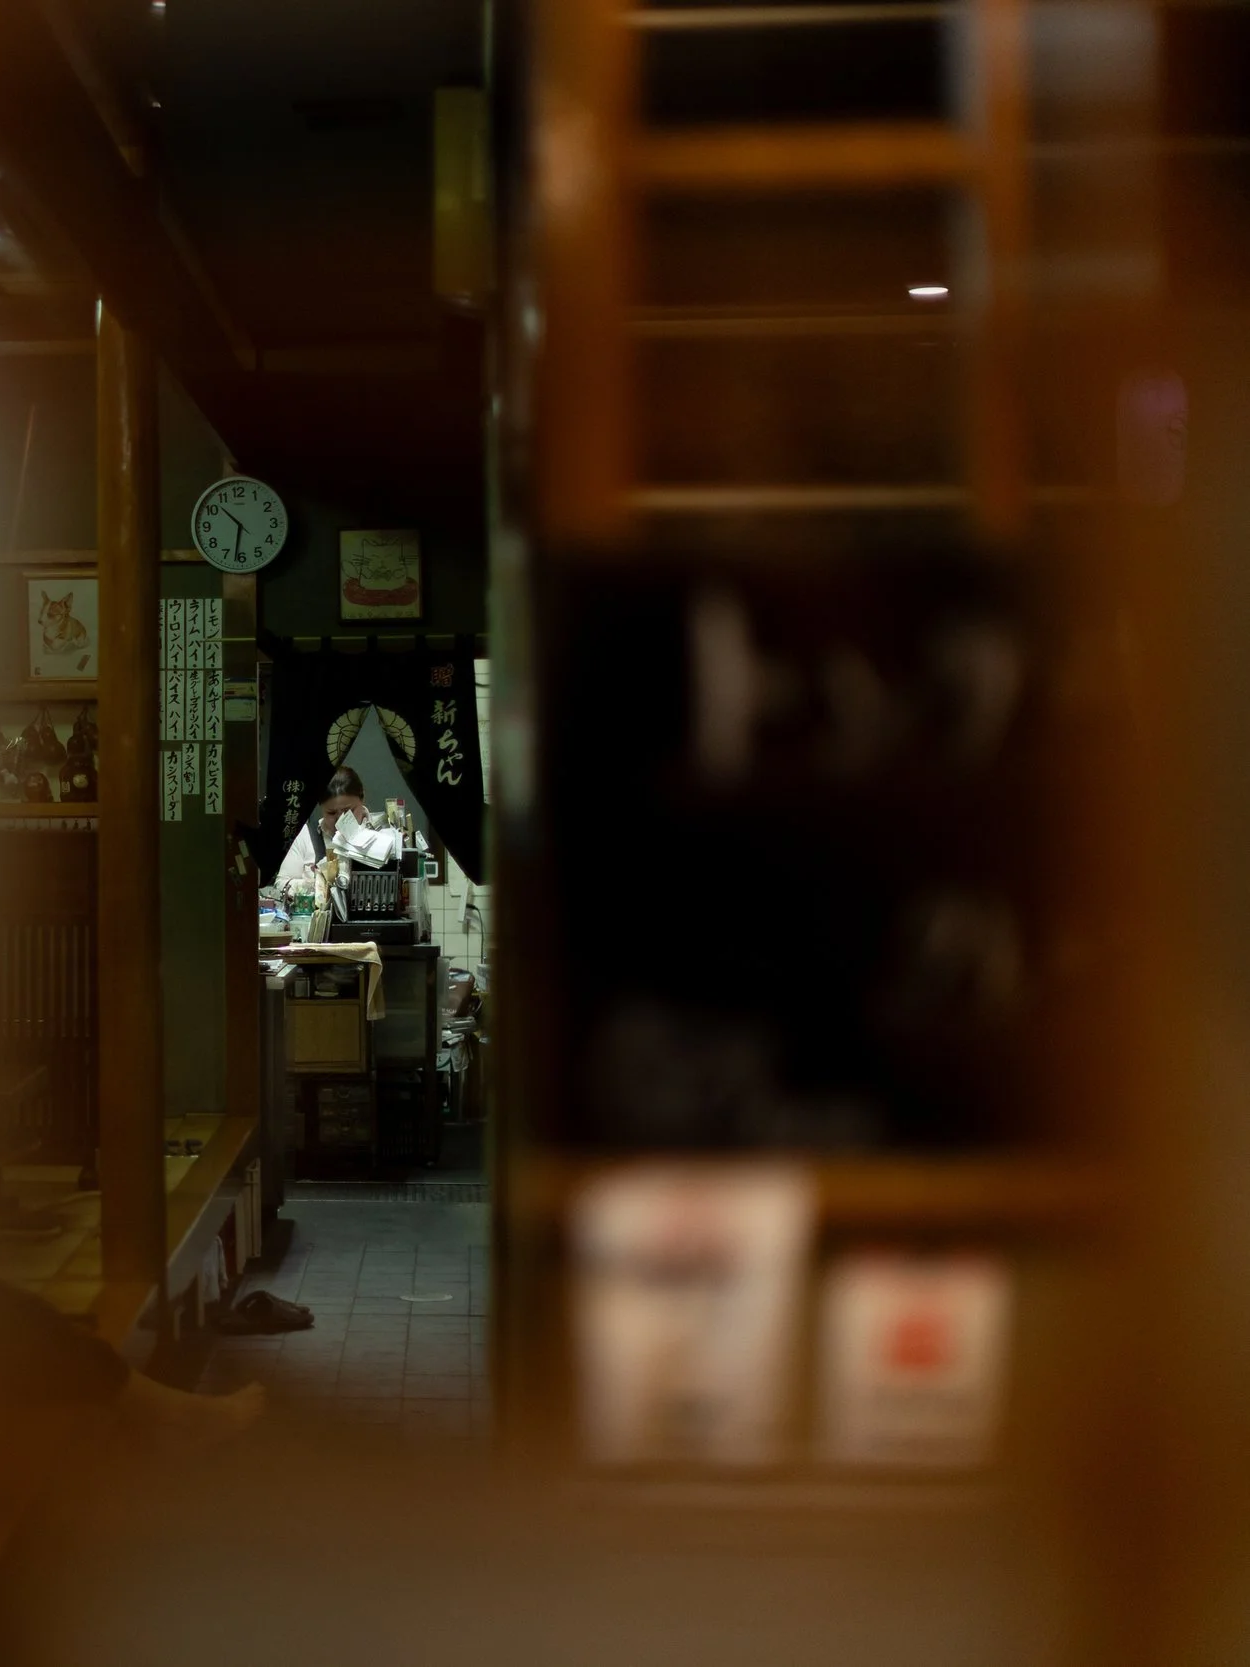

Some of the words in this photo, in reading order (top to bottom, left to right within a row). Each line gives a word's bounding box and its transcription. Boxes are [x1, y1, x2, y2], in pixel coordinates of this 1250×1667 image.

[218, 492, 228, 503] 11
[232, 487, 245, 498] 12
[252, 490, 258, 501] 1
[206, 504, 219, 516] 10
[263, 501, 272, 513] 2
[202, 521, 211, 532] 9
[270, 518, 278, 529] 3
[209, 537, 218, 548] 8
[264, 534, 274, 545] 4
[221, 548, 230, 559] 7
[237, 552, 247, 563] 6
[253, 546, 263, 558] 5
[169, 600, 183, 663] ウーロンハイ
[188, 599, 201, 662] ライムハイ
[207, 599, 220, 663] レモンハイ
[206, 670, 221, 733] あんずハイ
[430, 699, 463, 786] 新ちゃん
[183, 743, 196, 793] カシス割り
[207, 744, 220, 812] カルピスハイ
